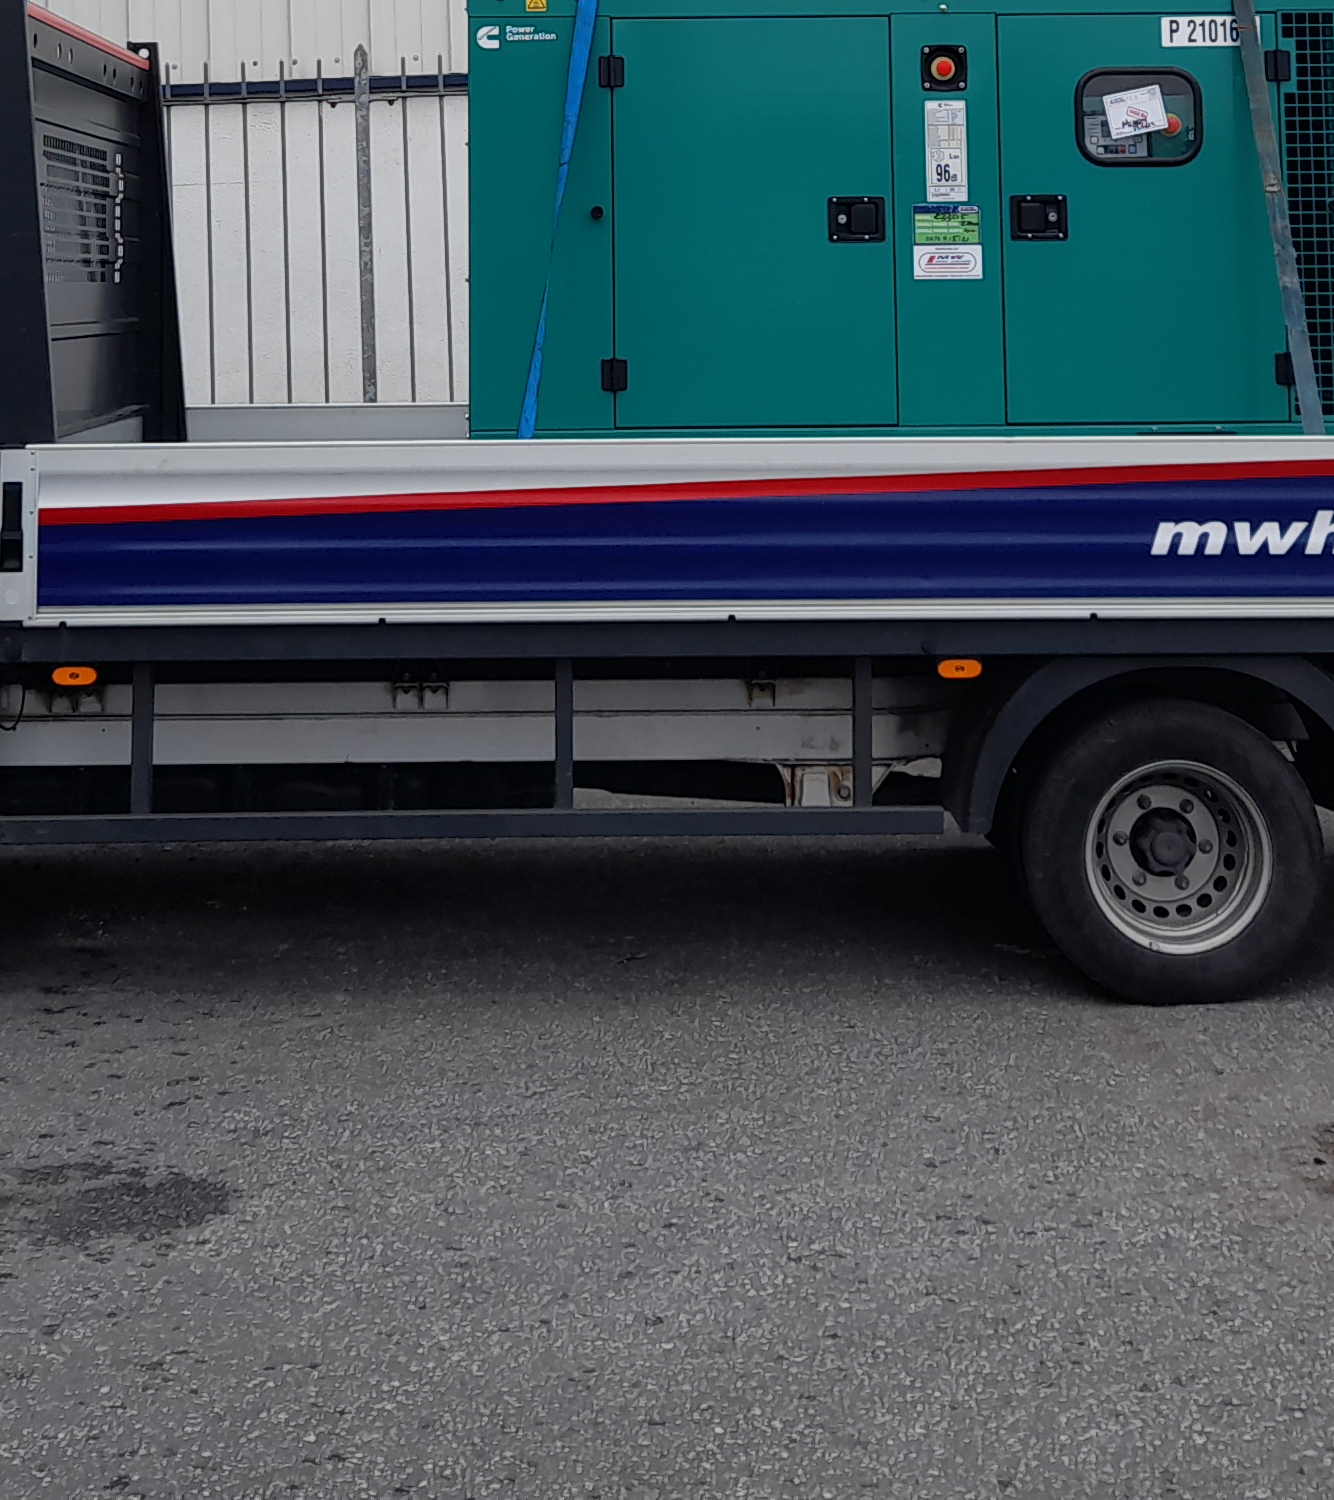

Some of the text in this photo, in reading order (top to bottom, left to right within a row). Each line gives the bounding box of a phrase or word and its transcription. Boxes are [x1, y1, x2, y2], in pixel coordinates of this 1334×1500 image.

[505, 25, 535, 33] Power
[1169, 19, 1180, 43] P
[505, 32, 557, 41] Generation
[935, 164, 951, 182] 96
